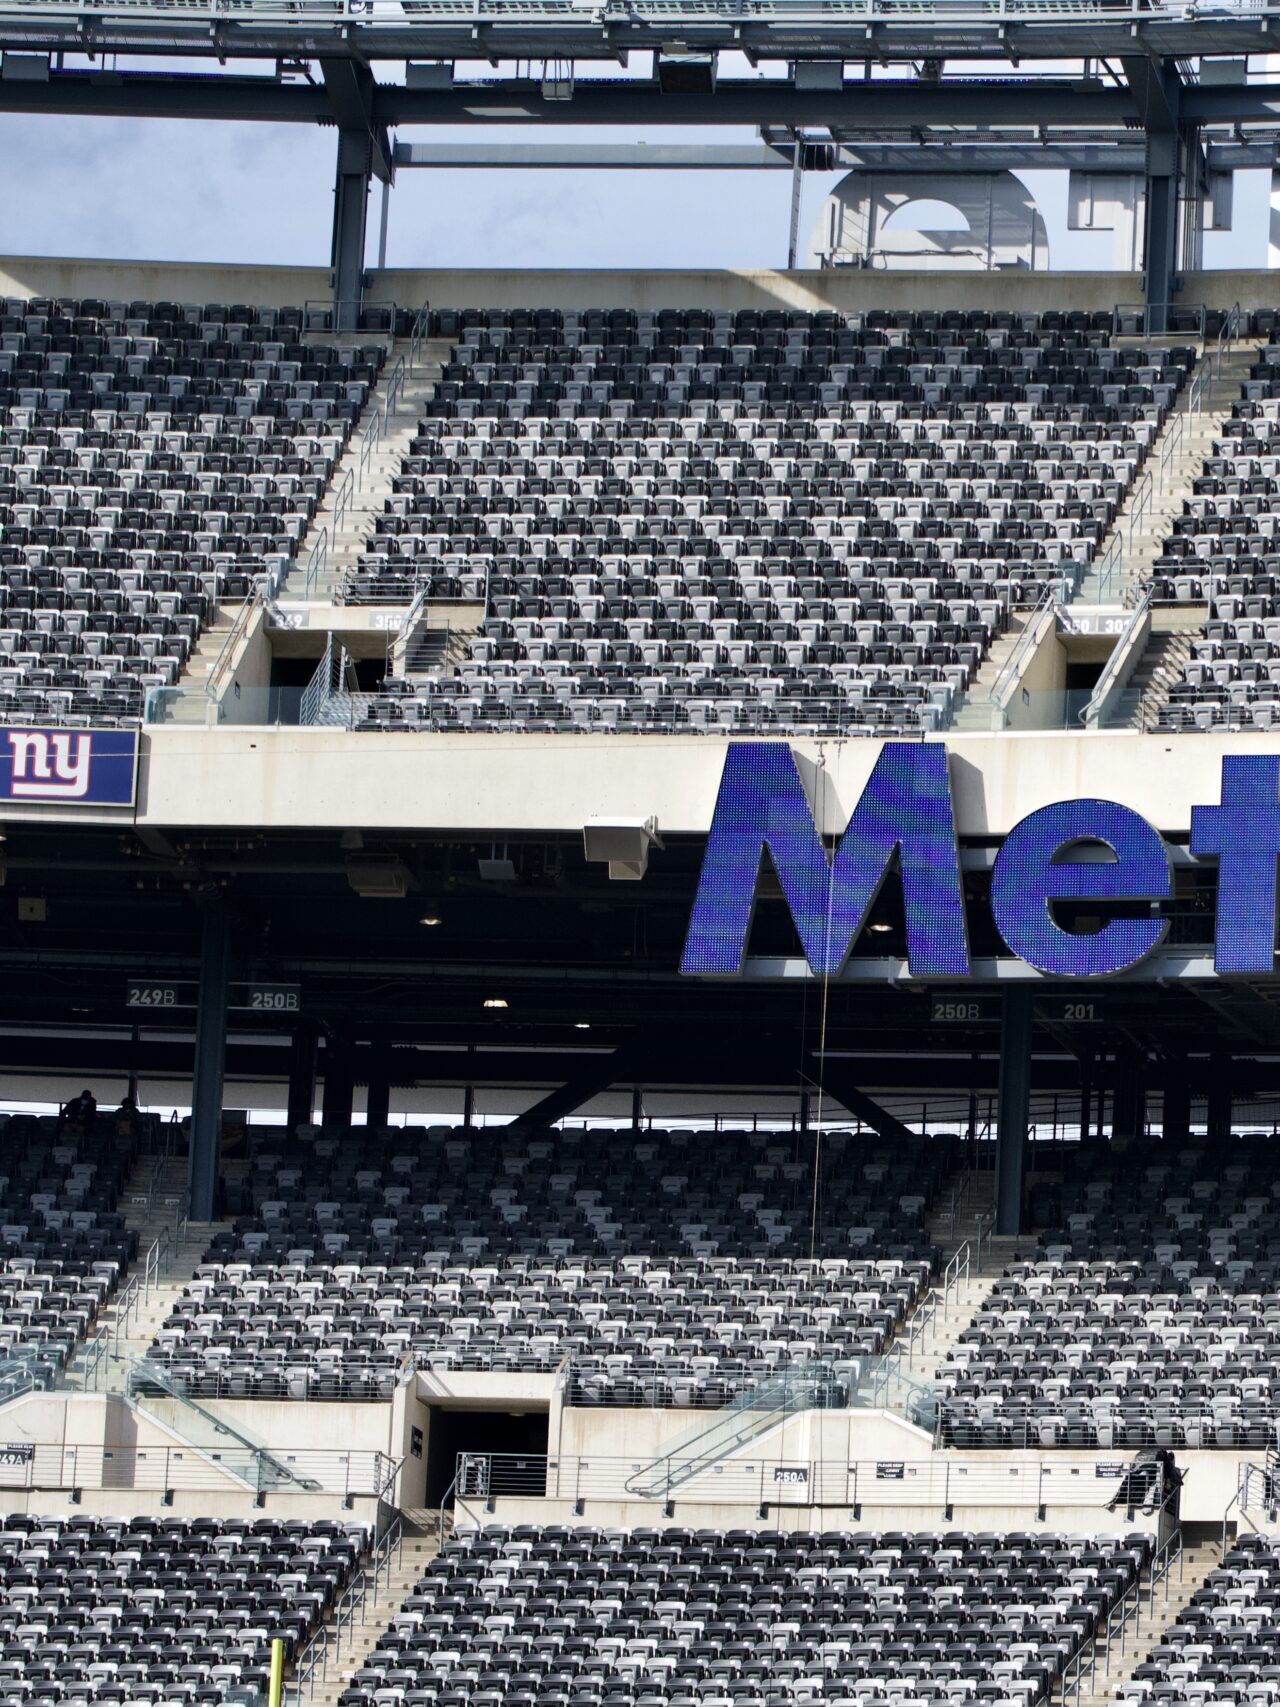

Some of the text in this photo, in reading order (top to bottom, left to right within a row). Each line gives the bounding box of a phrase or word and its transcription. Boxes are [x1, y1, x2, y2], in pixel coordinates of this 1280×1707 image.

[129, 989, 175, 1006] 249B
[251, 993, 298, 1009] 250B
[934, 1004, 980, 1019] 250B
[1064, 1004, 1095, 1019] 201
[0, 1454, 24, 1465] 49A
[776, 1472, 805, 1482] 250A
